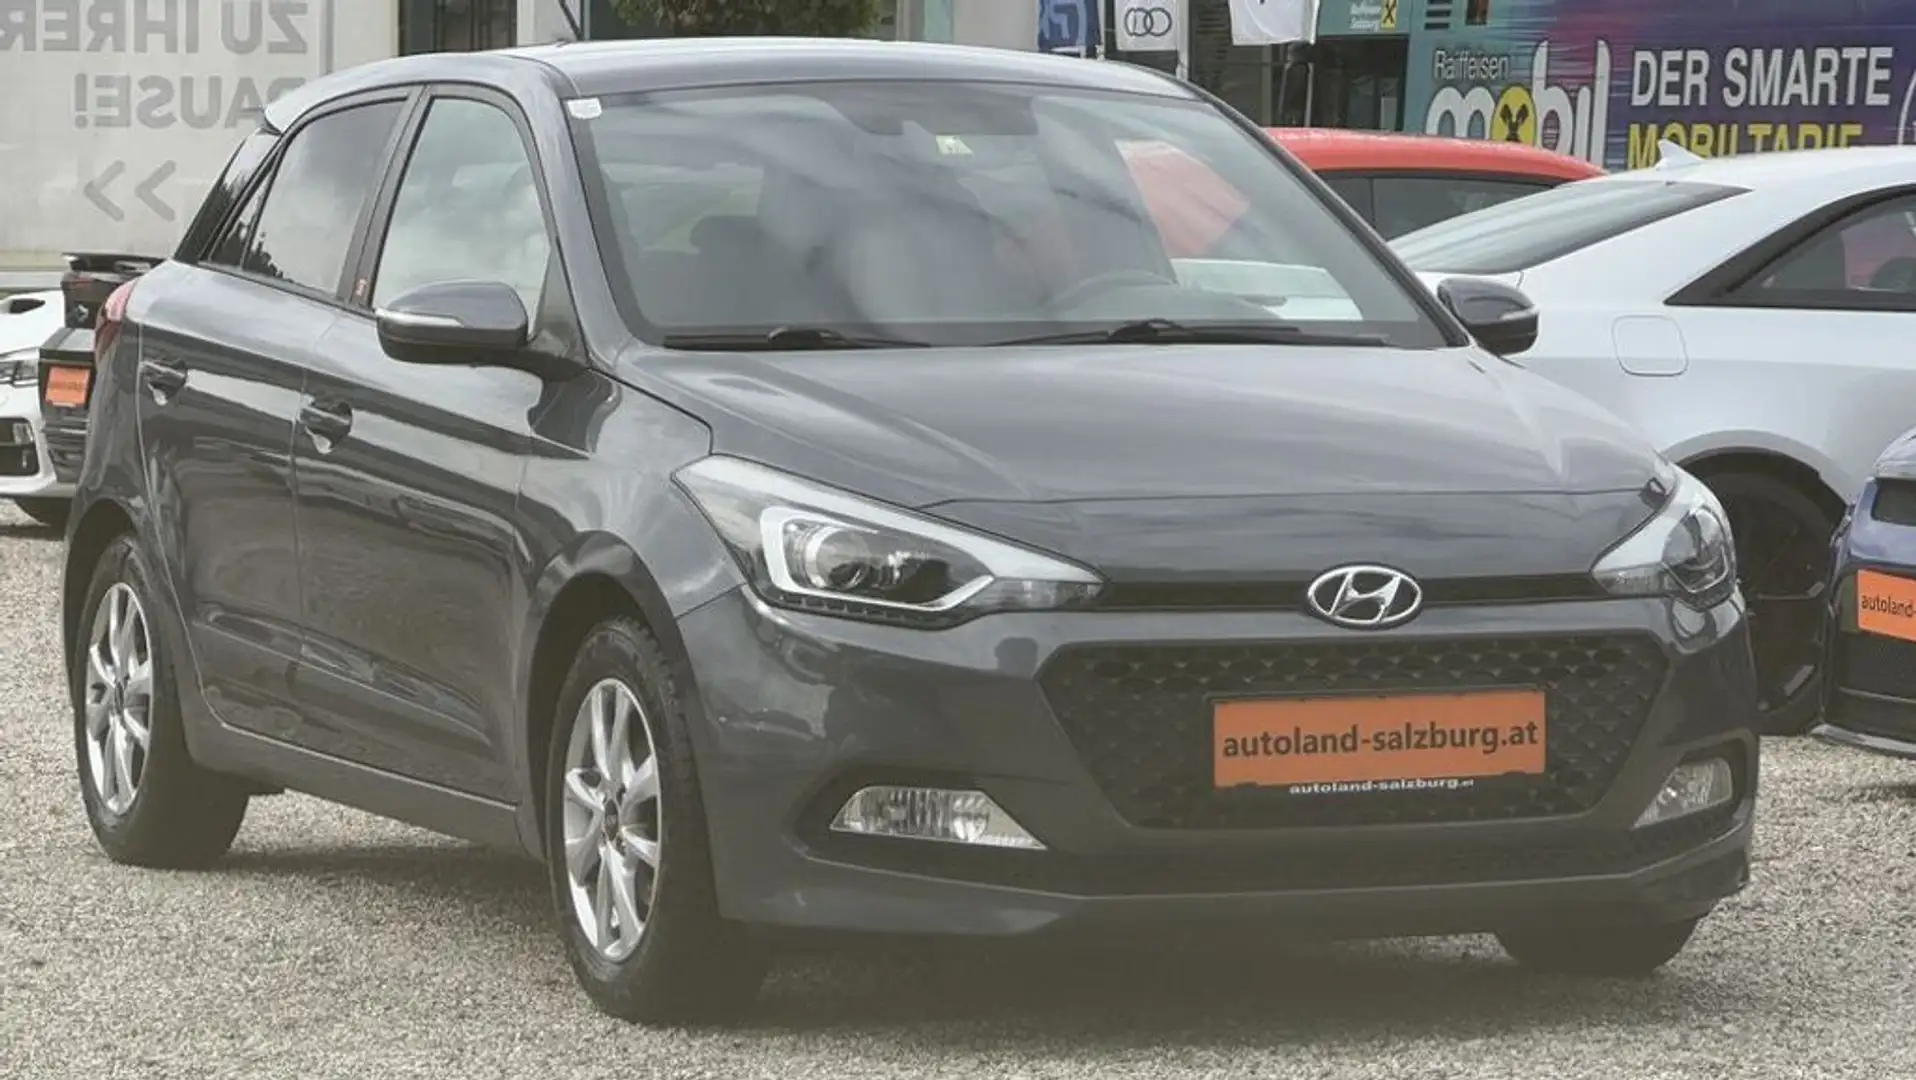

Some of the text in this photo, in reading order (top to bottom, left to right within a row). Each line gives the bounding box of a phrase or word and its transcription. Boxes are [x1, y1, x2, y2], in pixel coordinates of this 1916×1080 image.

[1434, 50, 1509, 80] Raiffeisen
[1631, 46, 1892, 107] DER SMARTE
[1222, 721, 1539, 758] autoland-salzburg.at
